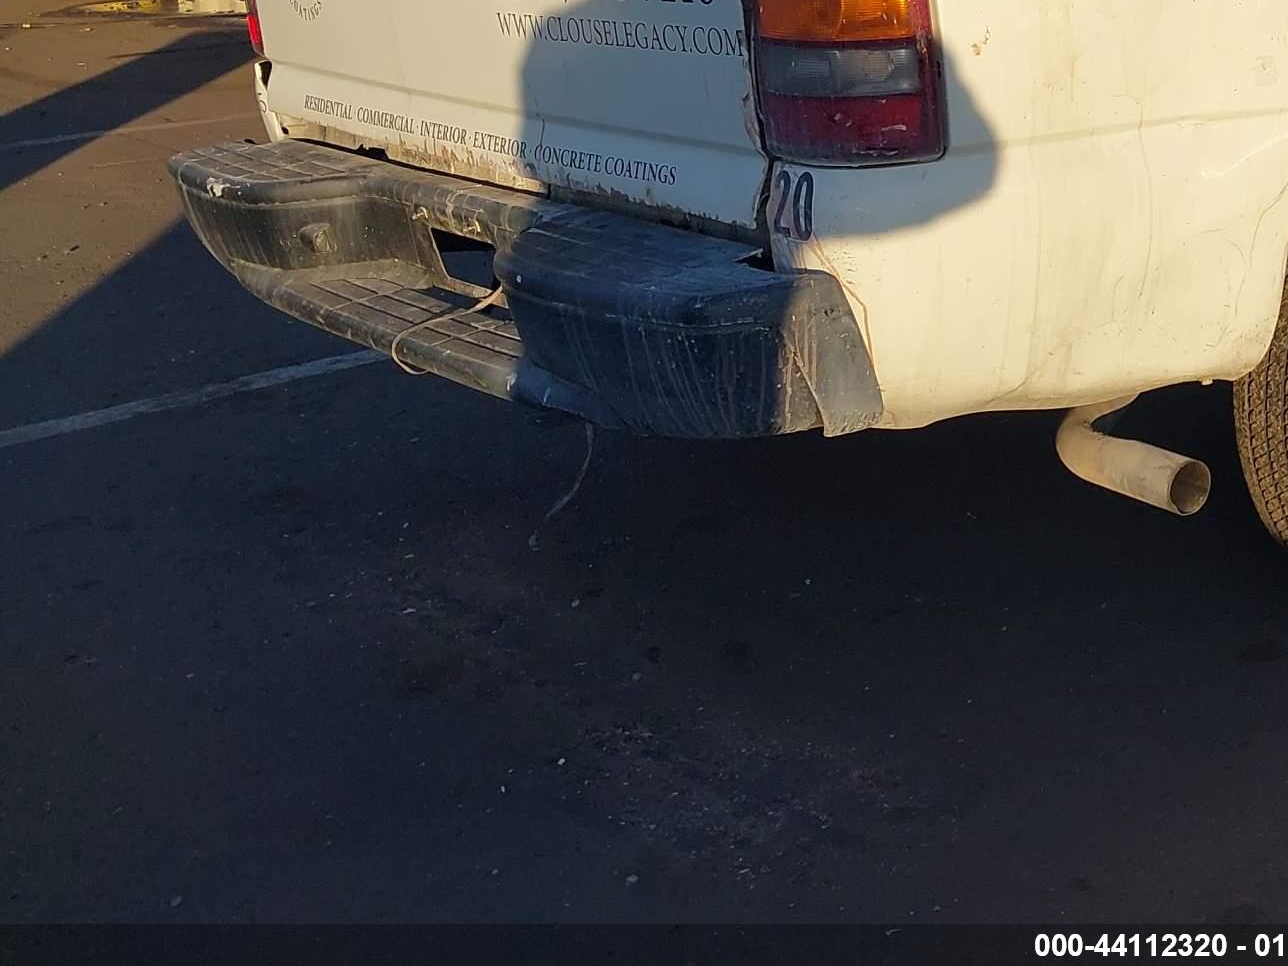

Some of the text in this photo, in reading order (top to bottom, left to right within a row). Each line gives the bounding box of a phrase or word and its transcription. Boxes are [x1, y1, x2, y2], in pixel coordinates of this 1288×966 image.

[496, 11, 745, 57] WWW.CLOUSELEGACY.COM
[304, 94, 677, 186] RESIDENTIAL COMMERCIAL INTERIOR EXTERIOR CONCRETE COATINGS
[773, 169, 814, 241] 20
